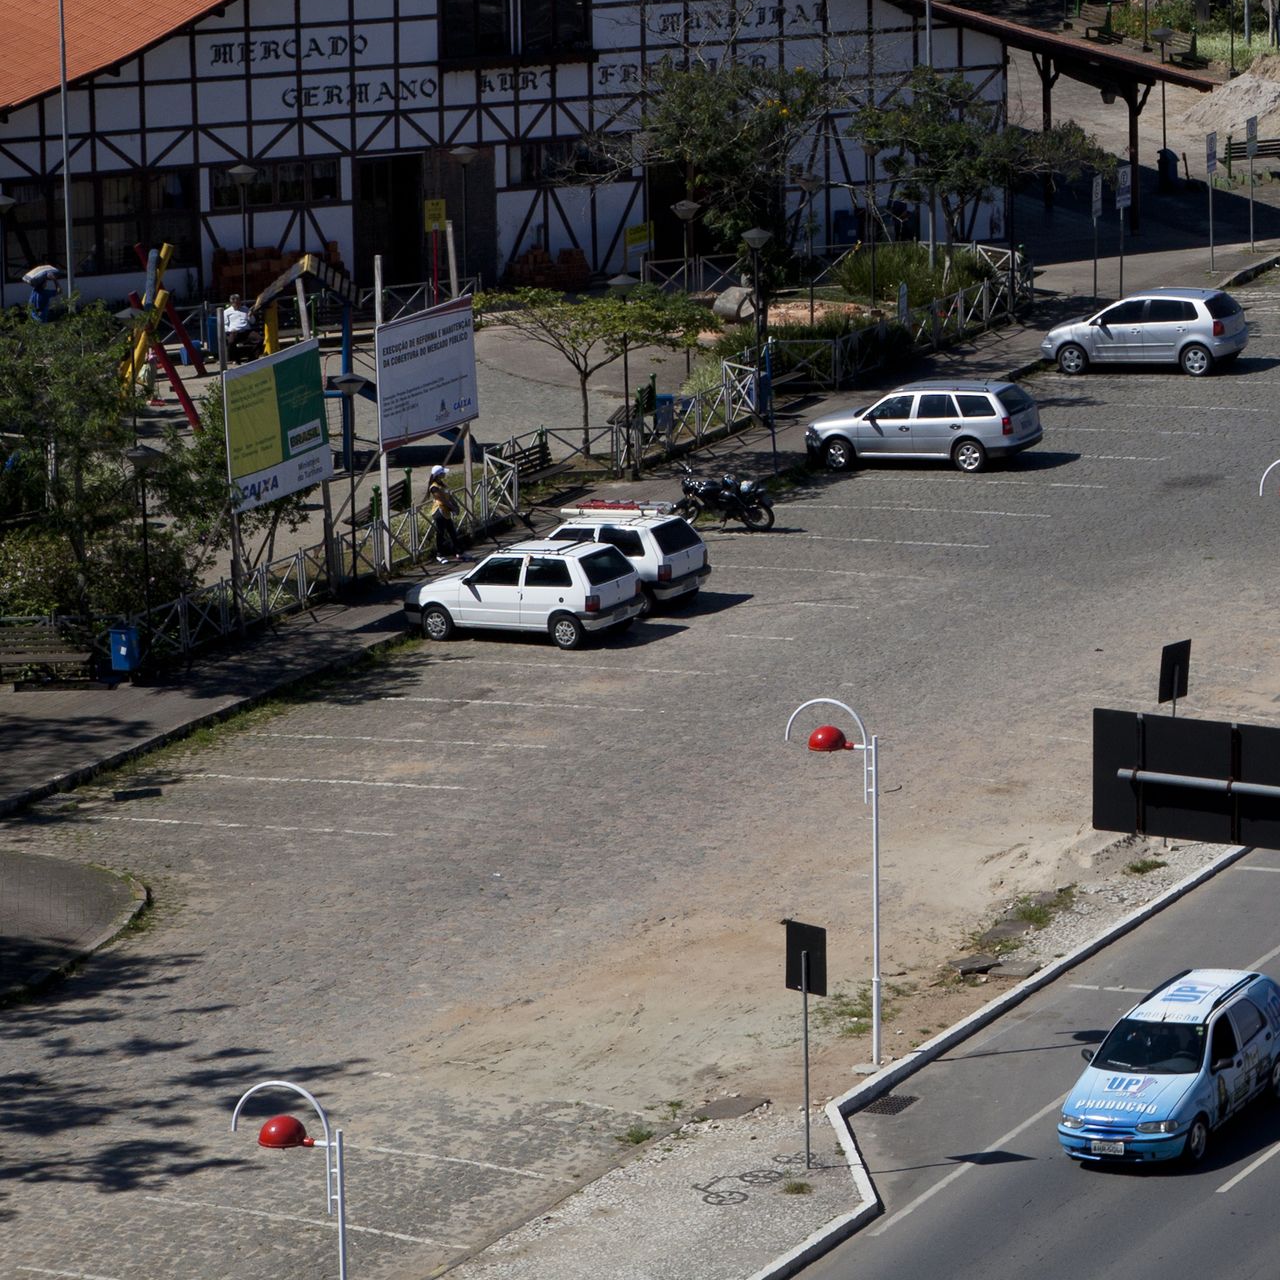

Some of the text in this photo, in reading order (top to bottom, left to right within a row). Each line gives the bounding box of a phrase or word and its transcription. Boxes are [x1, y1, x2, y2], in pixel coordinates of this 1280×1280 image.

[211, 33, 368, 67] MERCADO
[281, 76, 438, 110] GERMANO
[382, 339, 409, 357] EXECUÇÃO
[241, 474, 279, 501] CAIXA
[1107, 1076, 1141, 1090] UP
[1074, 1099, 1158, 1115] PRODUÇÃO
